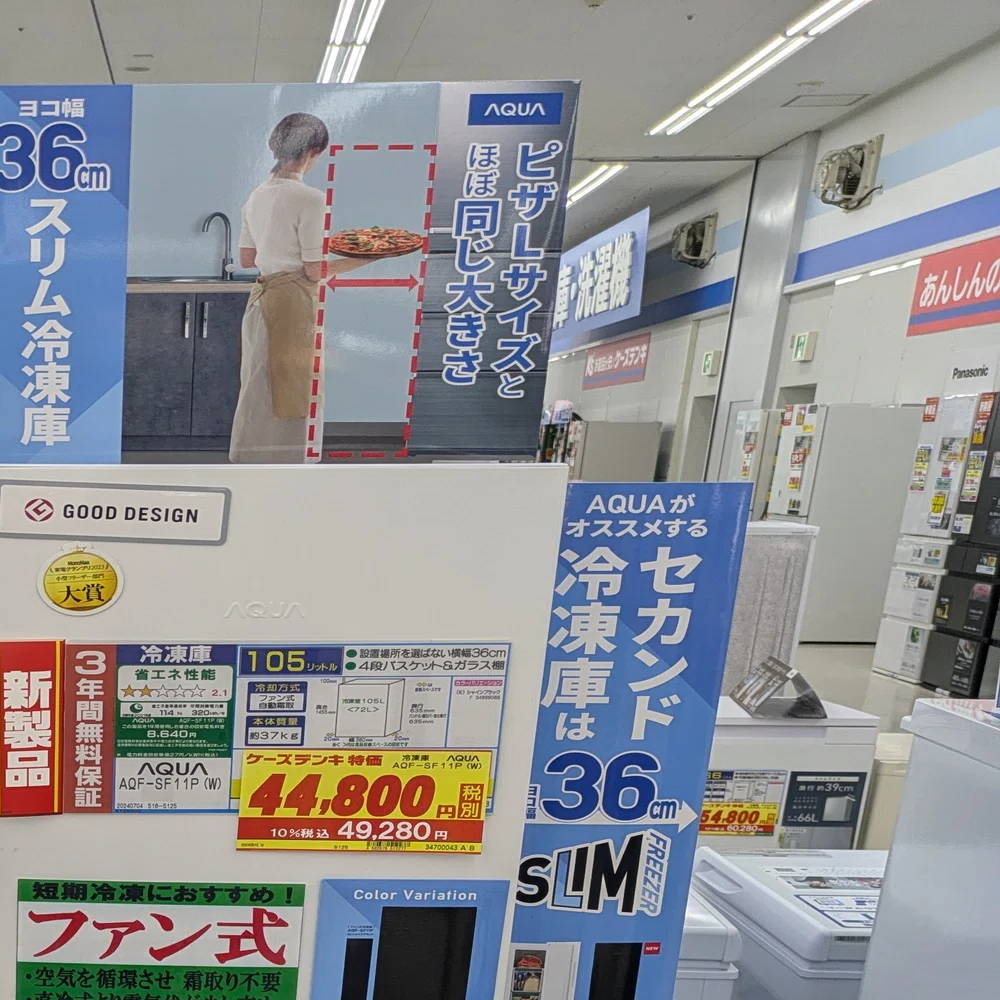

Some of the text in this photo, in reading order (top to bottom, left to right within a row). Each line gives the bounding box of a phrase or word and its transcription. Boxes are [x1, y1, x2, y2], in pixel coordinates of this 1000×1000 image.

[18, 98, 84, 119] ヨコ幅
[483, 102, 546, 118] AQUA
[441, 142, 502, 386] ほぼ同じ大きさ
[491, 140, 565, 399] ピザLサイズと
[919, 259, 1000, 307] あんしんの
[20, 198, 74, 446] スリム冷凍庫
[952, 365, 989, 380] Panasonic
[62, 504, 200, 525] GOOD DESIGN
[585, 494, 696, 516] AQUAが
[566, 518, 709, 539] オススメする
[58, 583, 106, 604] 大賞
[224, 601, 306, 620] AQUA
[359, 648, 507, 659] 設置場所を選ばない横幅36cm
[541, 546, 630, 741] 冷凍庫は
[627, 546, 703, 741] セカンド
[139, 645, 212, 664] 冷凍庫
[134, 668, 216, 681] 省エネ性能
[212, 689, 228, 697] 2.1
[254, 683, 301, 692] 冷却方式
[3, 670, 53, 788] 新製品
[74, 651, 107, 808] 3年間無料保証
[253, 717, 298, 726] 本体質量
[250, 731, 299, 741] 約37kg
[246, 754, 383, 766] ケーズデンキ 特価
[392, 762, 462, 770] AQF-SF11P
[402, 754, 480, 762] 冷凍庫 AQUA
[137, 762, 209, 776] AQUA
[119, 777, 199, 791] AQF-SF11P
[540, 751, 677, 823] 36cm
[461, 785, 482, 818] 税別
[516, 833, 645, 914] SLIM
[640, 831, 670, 916] FREEZER
[353, 889, 477, 901] Color Variation
[27, 907, 290, 965] ファン式
[182, 971, 282, 994] 霜取り不要
